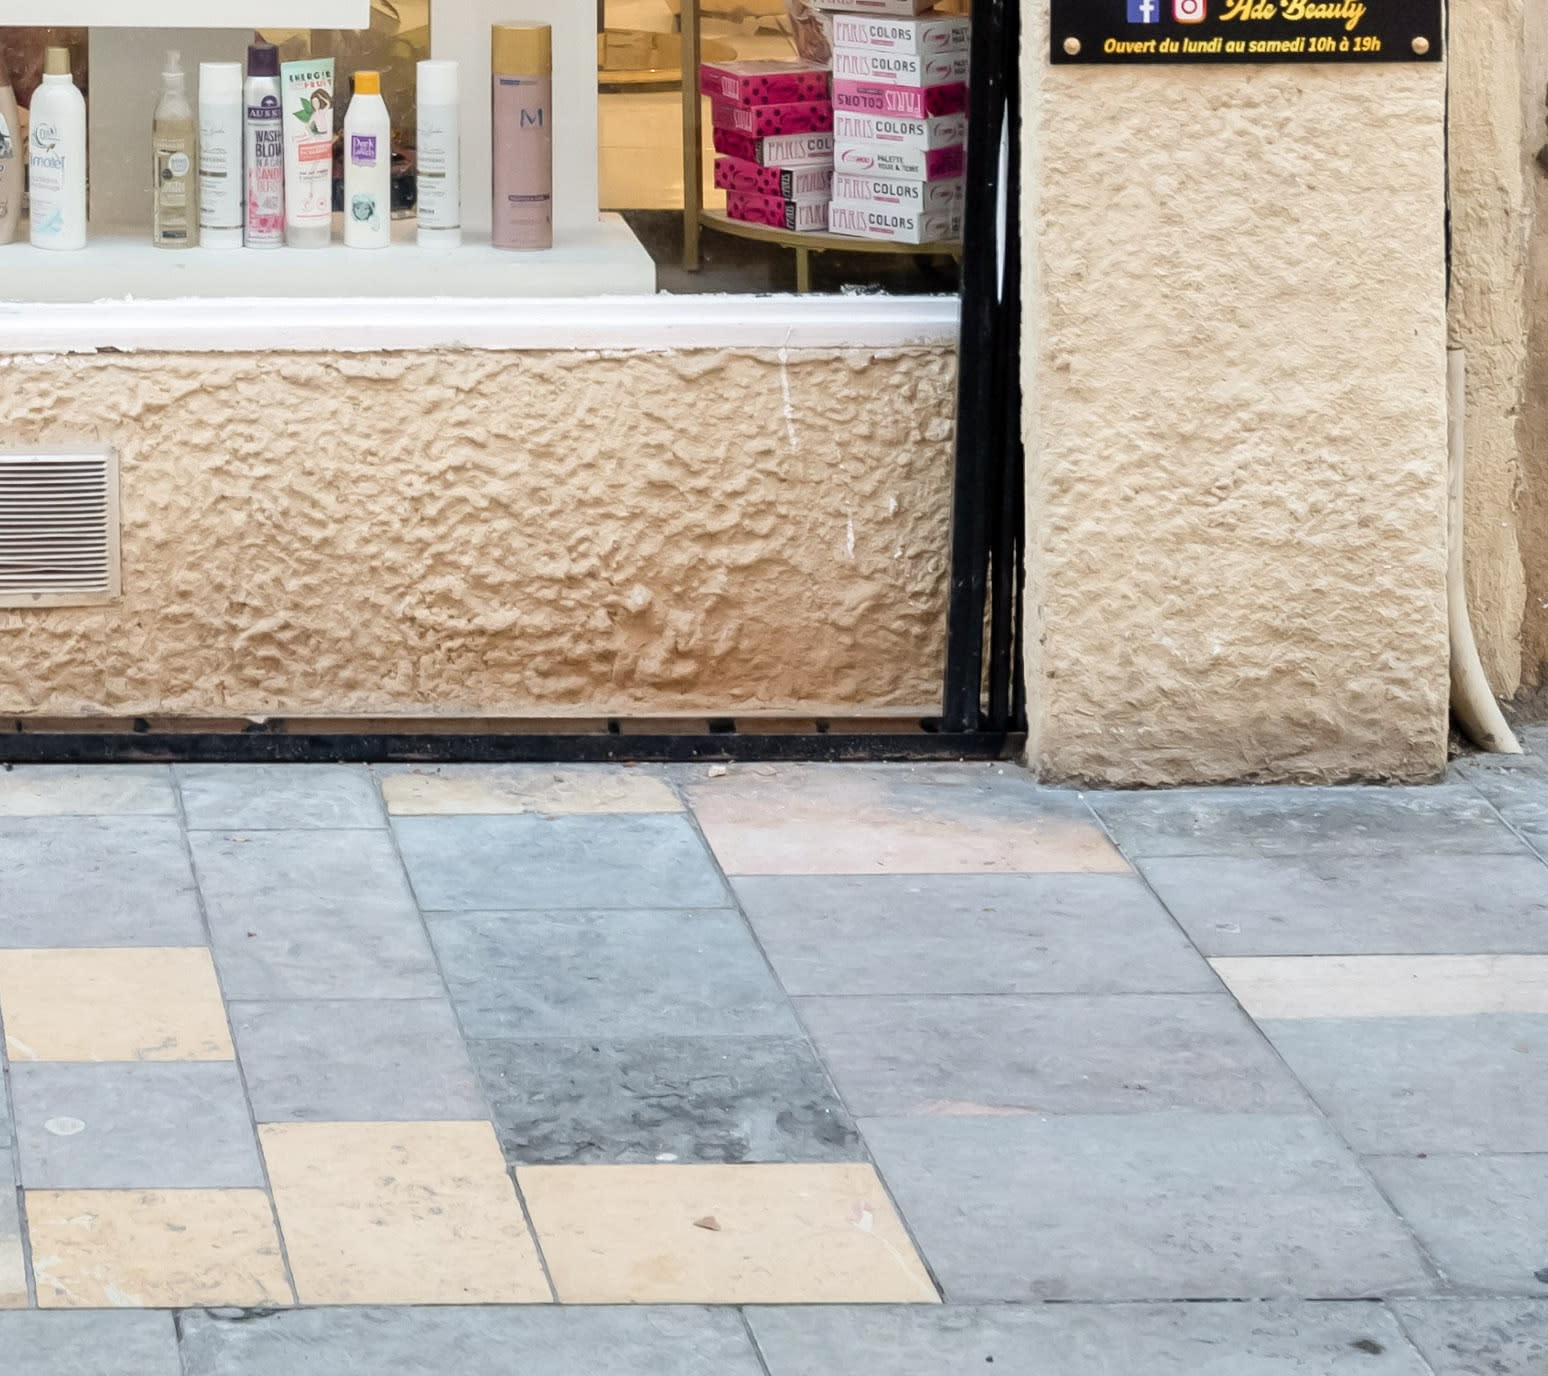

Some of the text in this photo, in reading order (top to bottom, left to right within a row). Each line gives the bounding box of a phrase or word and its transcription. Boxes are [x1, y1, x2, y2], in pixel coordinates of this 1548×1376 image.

[836, 23, 912, 44] PARIS COLORS
[836, 55, 916, 76] PARIS COLORS
[836, 117, 924, 139] PARIS COLORS
[836, 178, 919, 199] PARIS COLORS
[832, 208, 914, 231] PARIS COLORS
